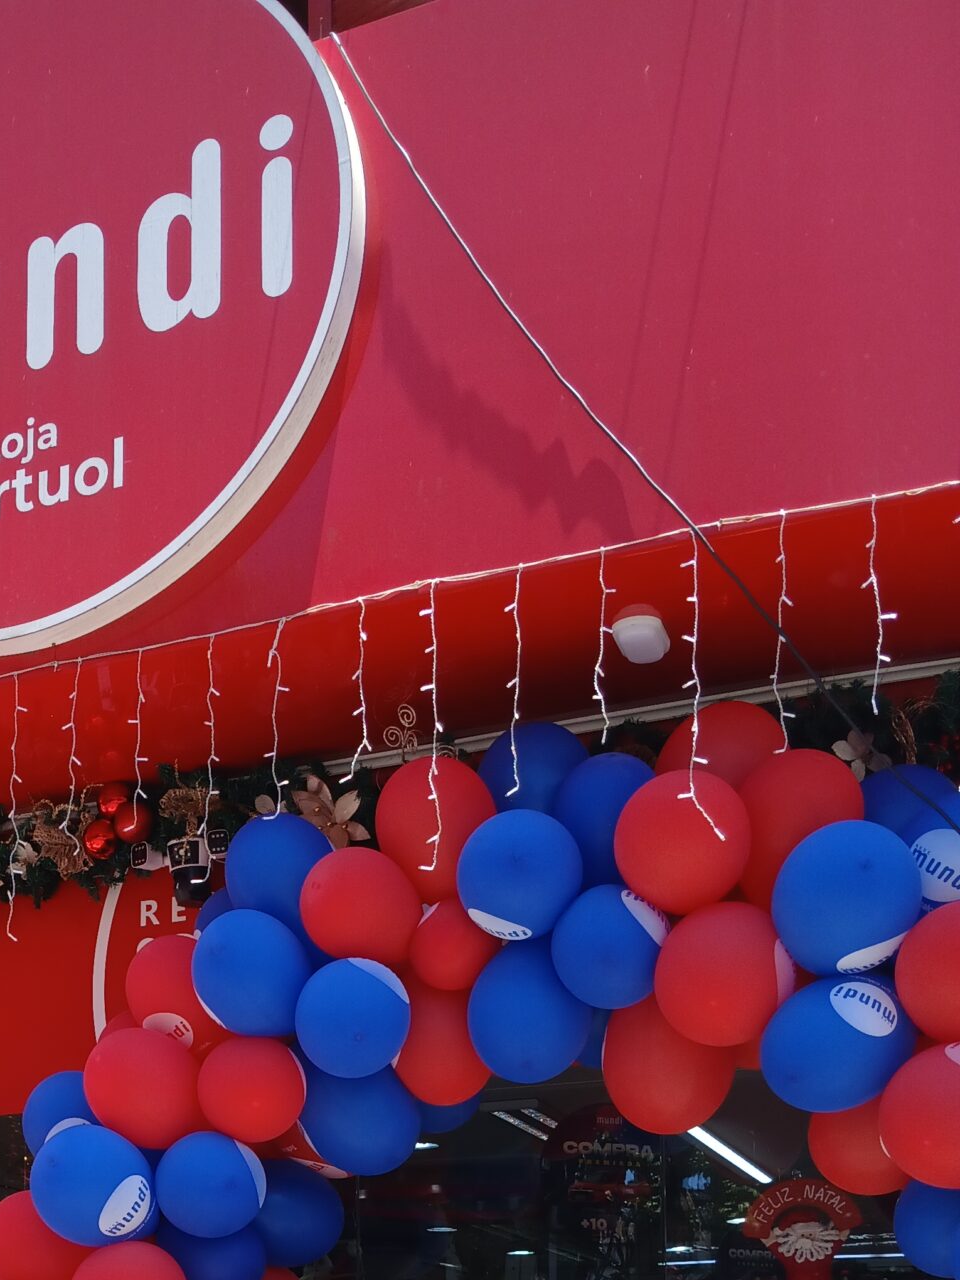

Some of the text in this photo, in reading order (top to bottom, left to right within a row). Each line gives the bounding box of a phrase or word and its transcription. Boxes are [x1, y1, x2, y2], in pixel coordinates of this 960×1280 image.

[140, 896, 187, 928] RE
[106, 1180, 149, 1235] mundi
[753, 1184, 847, 1223] FELIZ NATAL
[581, 1218, 608, 1231] +10
